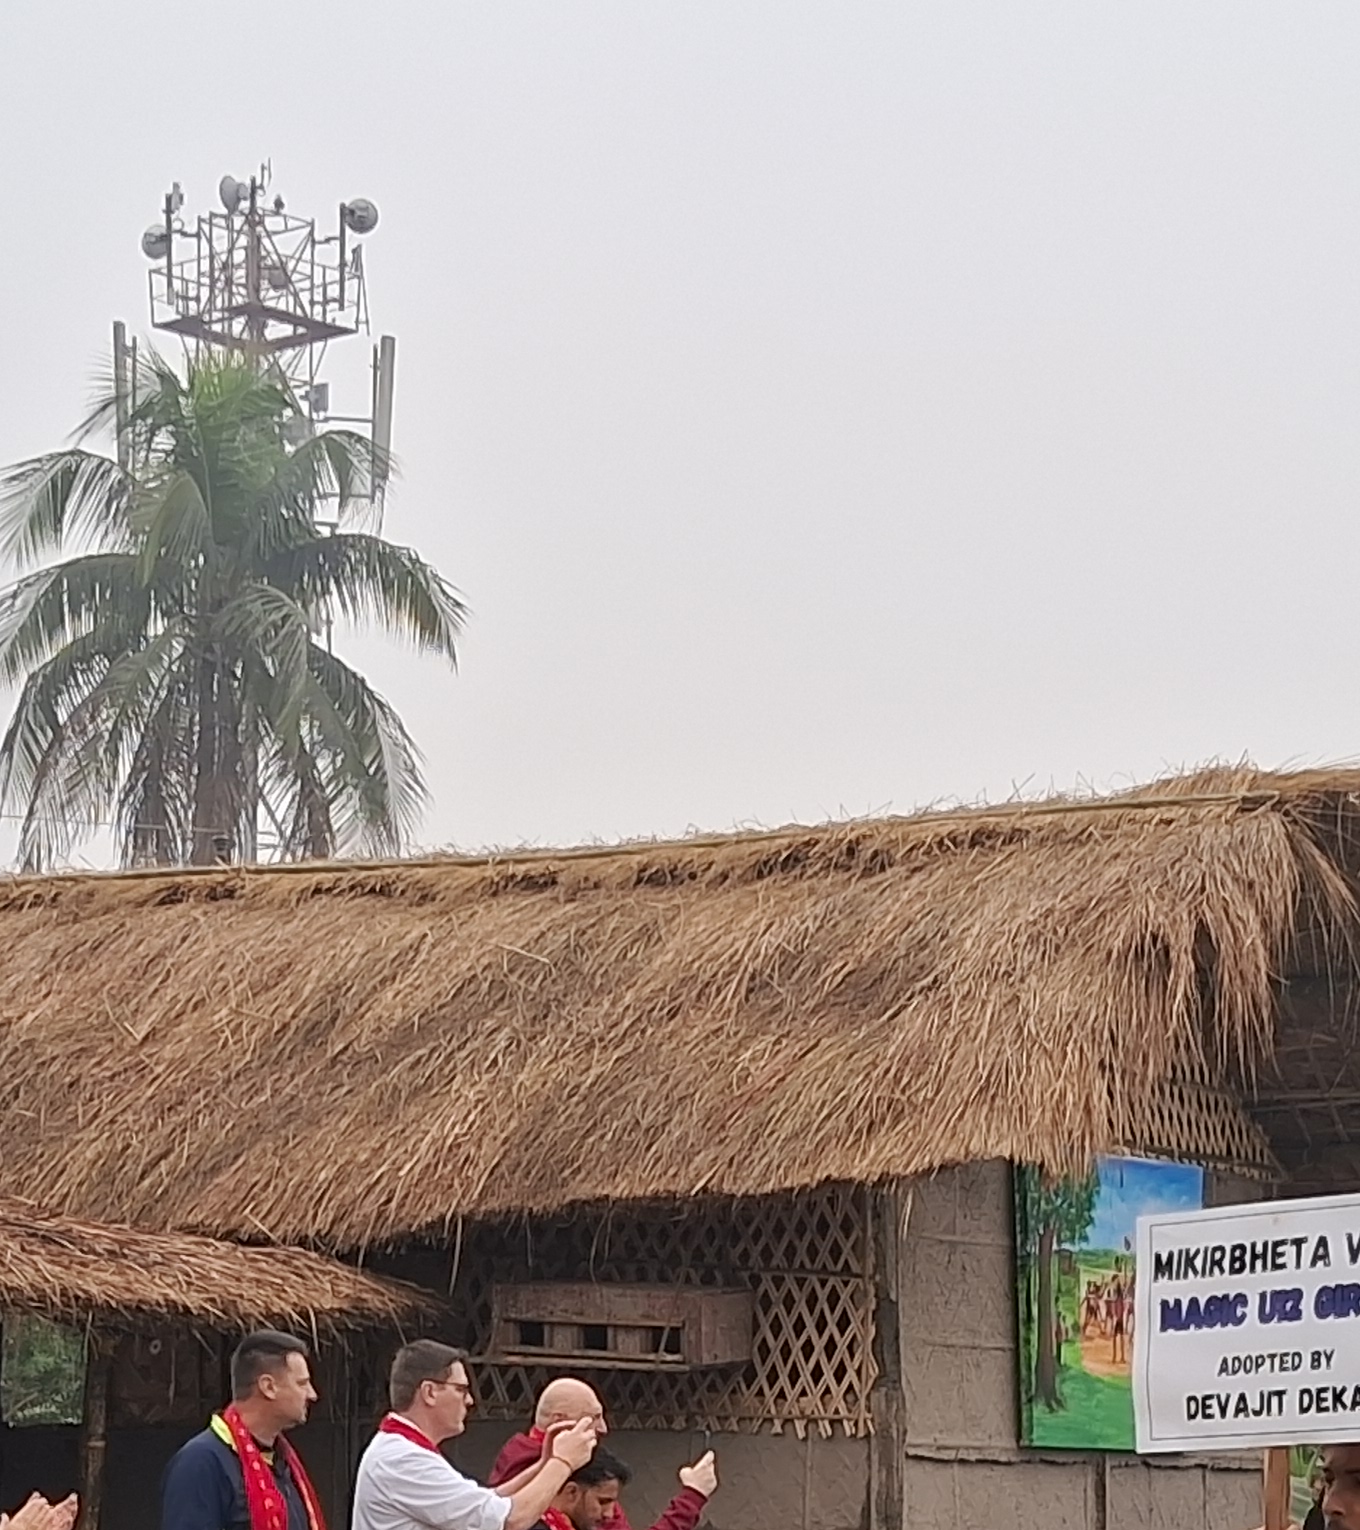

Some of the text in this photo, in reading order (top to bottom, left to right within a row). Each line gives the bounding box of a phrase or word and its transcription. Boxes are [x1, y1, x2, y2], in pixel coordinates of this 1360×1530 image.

[1153, 1236, 1331, 1282] MIKIRBHETA
[1159, 1292, 1248, 1332] MAGIC
[1217, 1349, 1335, 1377] ADOPTED BY
[1186, 1388, 1288, 1421] DEVAJIT
